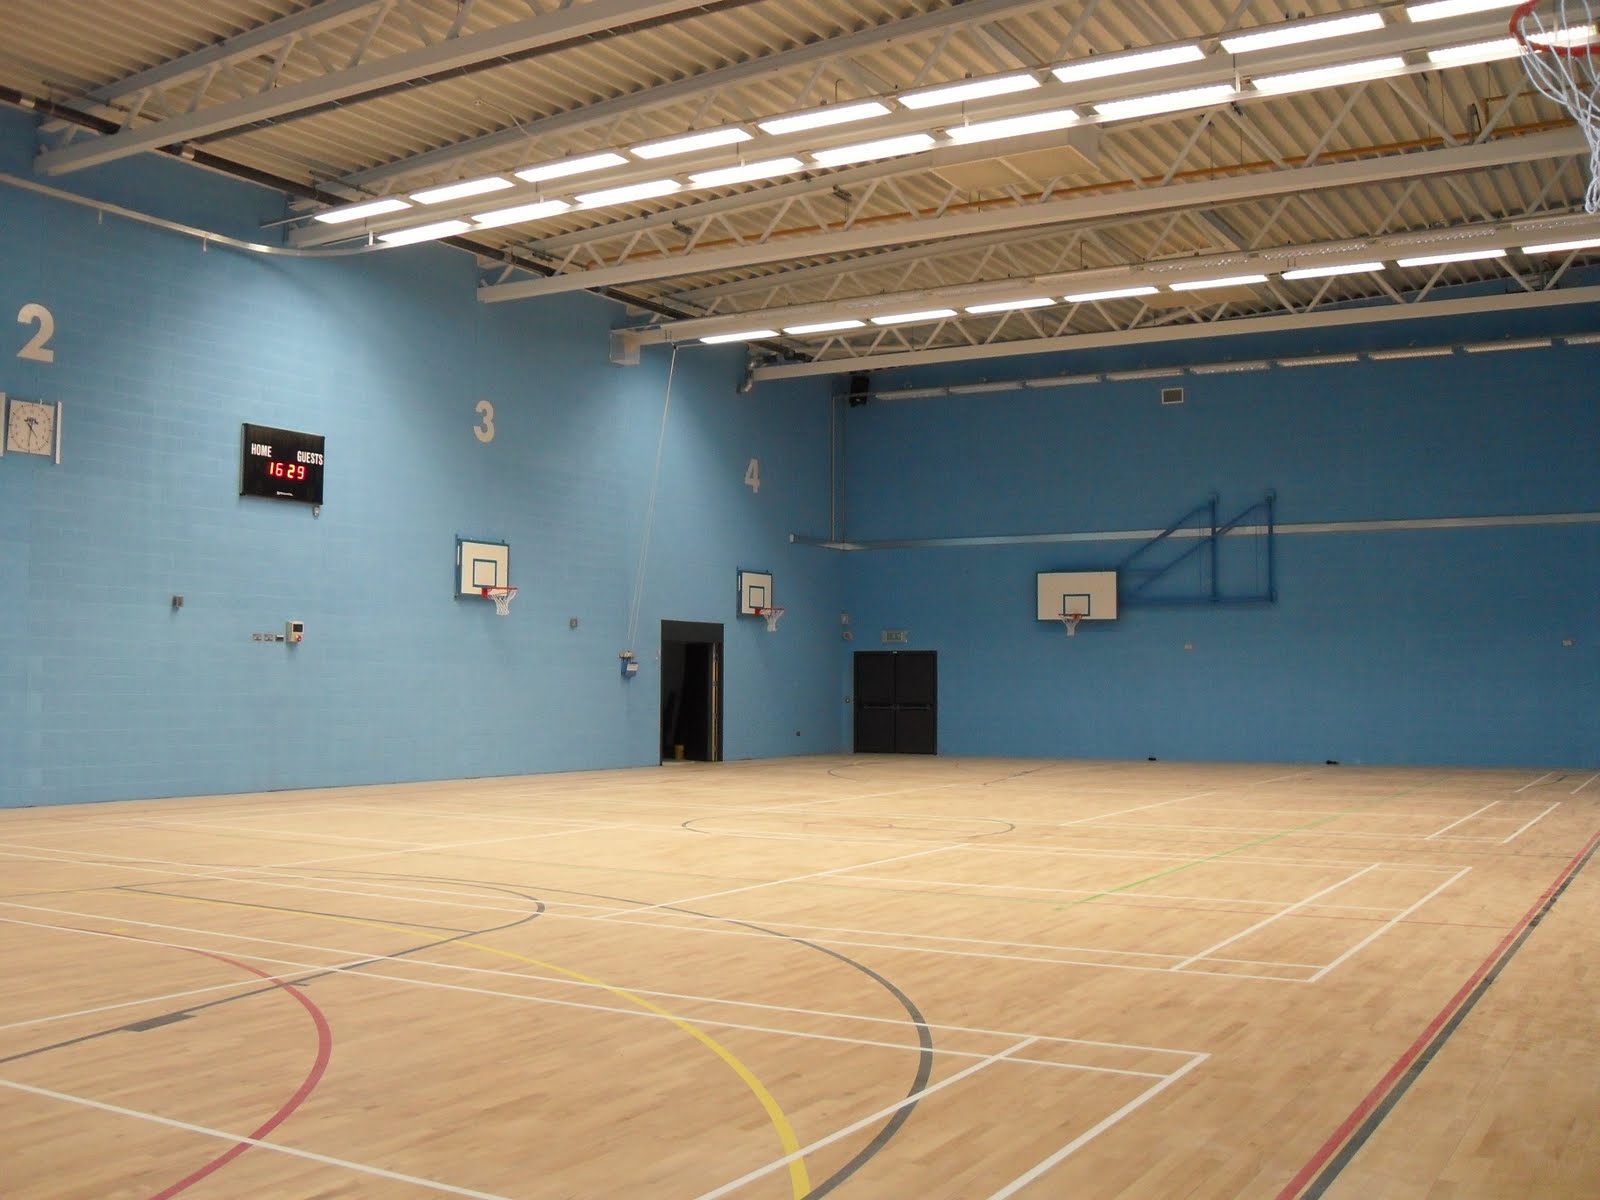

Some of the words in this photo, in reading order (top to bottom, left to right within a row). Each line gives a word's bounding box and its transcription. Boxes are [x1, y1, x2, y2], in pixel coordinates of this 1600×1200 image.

[16, 302, 55, 363] 2
[473, 400, 495, 443] 3
[251, 443, 273, 458] HOME
[296, 450, 324, 466] GUESTS
[743, 457, 761, 494] 4
